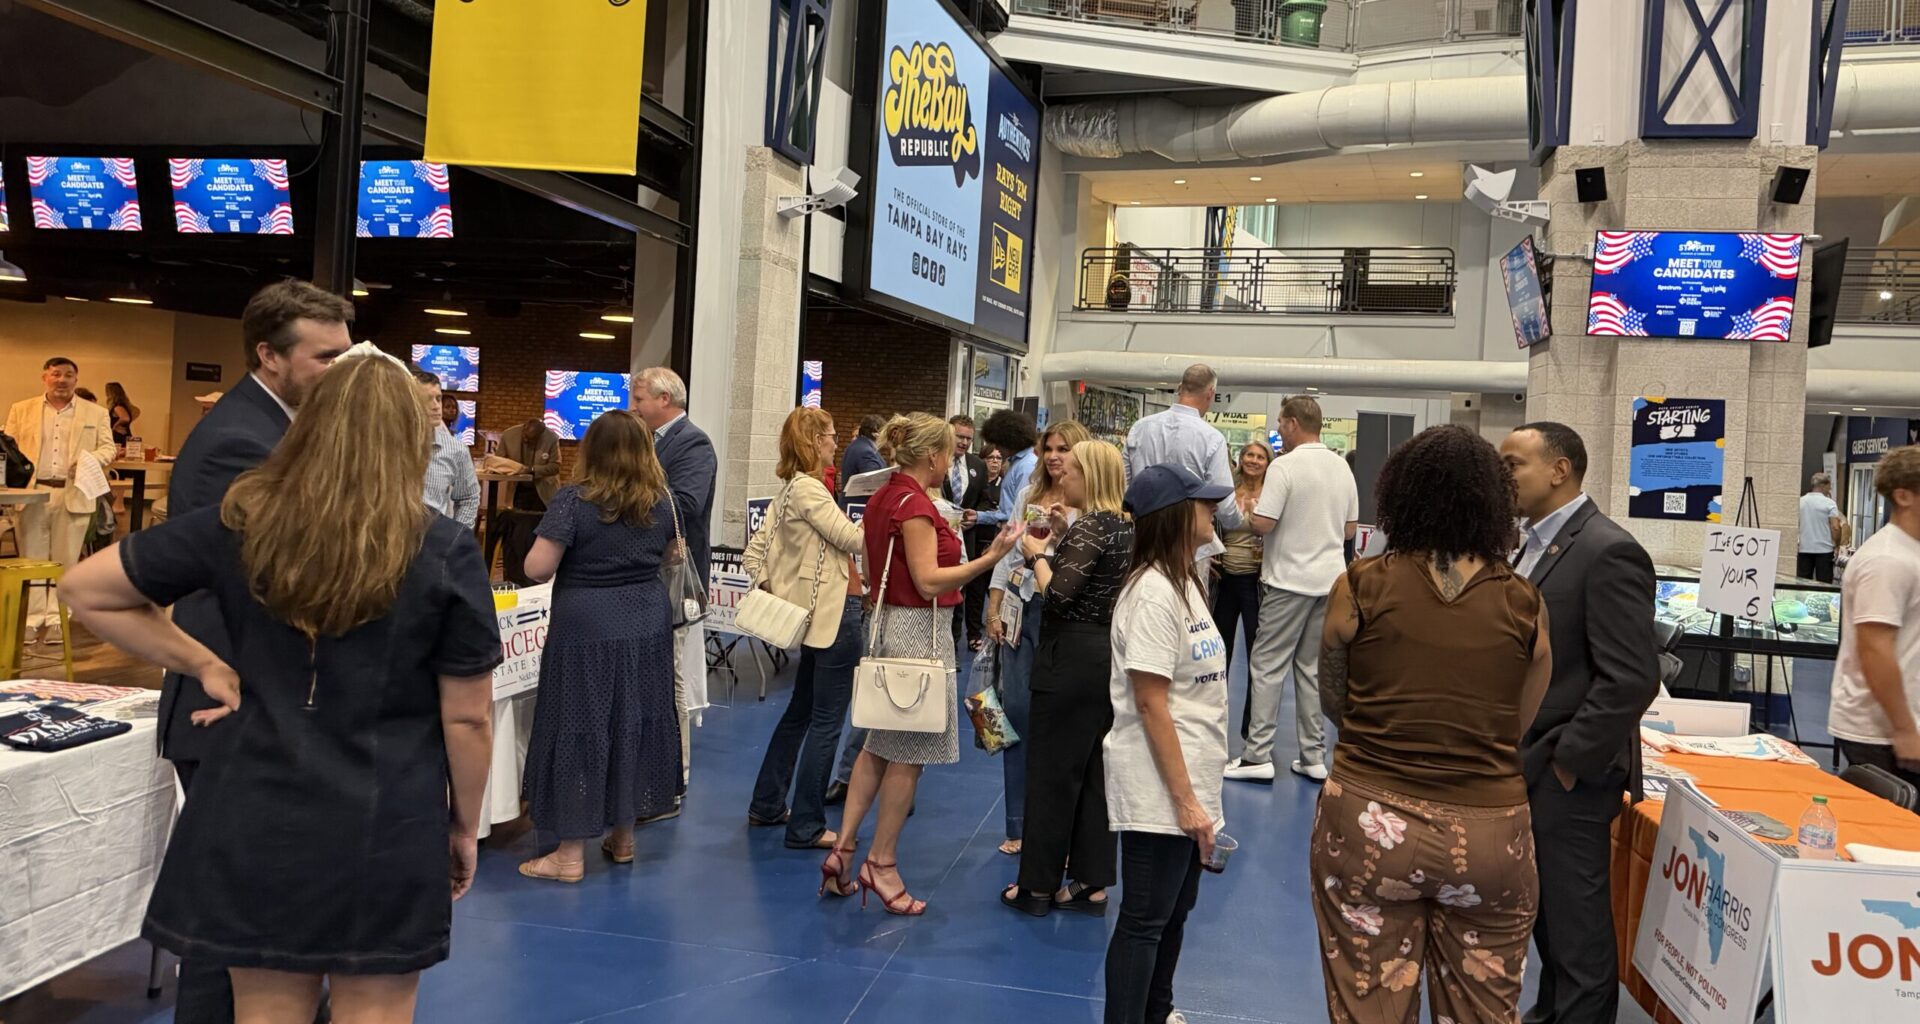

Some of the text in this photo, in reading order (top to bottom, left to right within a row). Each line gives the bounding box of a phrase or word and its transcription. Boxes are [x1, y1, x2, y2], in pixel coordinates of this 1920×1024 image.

[900, 138, 949, 157] REPUBLIC
[61, 181, 104, 189] CANDIDATES
[374, 179, 394, 187] MEET
[996, 162, 1014, 192] RAYS
[367, 186, 414, 194] CANDIDATES
[893, 187, 966, 238] THE OFFICIAL STORE OF THE
[999, 191, 1021, 220] RIGHT
[888, 203, 967, 262] TAMPA BAY RAYS
[1668, 258, 1722, 269] MEET THE
[1653, 268, 1735, 279] CANDIDATES
[576, 395, 621, 403] CANDIDATES
[1646, 408, 1711, 426] STARTING
[1673, 424, 1683, 438] 9
[1852, 437, 1888, 455] GUEST SERVICES
[1732, 534, 1771, 556] GOT
[711, 552, 725, 560] DOES
[726, 553, 733, 561] IT
[1720, 563, 1758, 590] YOUR
[1746, 597, 1760, 617] 6
[1195, 672, 1218, 684] VOTE
[1663, 846, 1751, 932] JON HARRIS
[1701, 902, 1747, 951] FOR CONGRESS
[1654, 928, 1665, 946] FOR
[1685, 961, 1699, 980] NOT
[1698, 974, 1727, 1010] POLITICS
